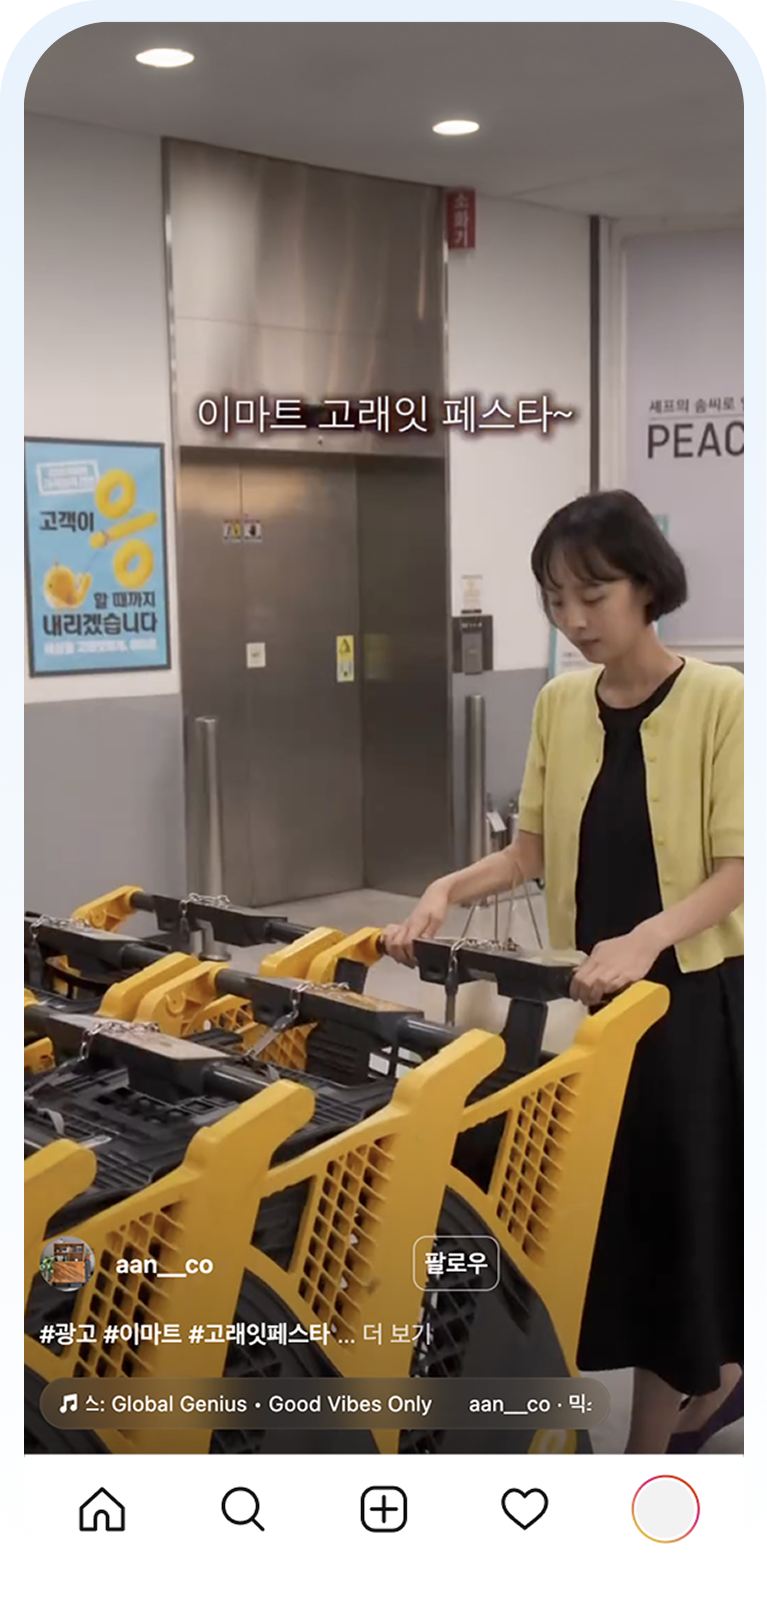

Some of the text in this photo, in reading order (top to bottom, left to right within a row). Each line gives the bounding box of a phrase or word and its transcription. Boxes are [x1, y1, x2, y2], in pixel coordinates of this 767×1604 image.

[453, 192, 470, 248] 소화기
[694, 396, 736, 414] 솜씨로
[647, 421, 744, 459] PEAC
[39, 510, 95, 533] 고객이
[93, 590, 156, 609] 할 때까지
[42, 611, 158, 637] 내리겠습니다
